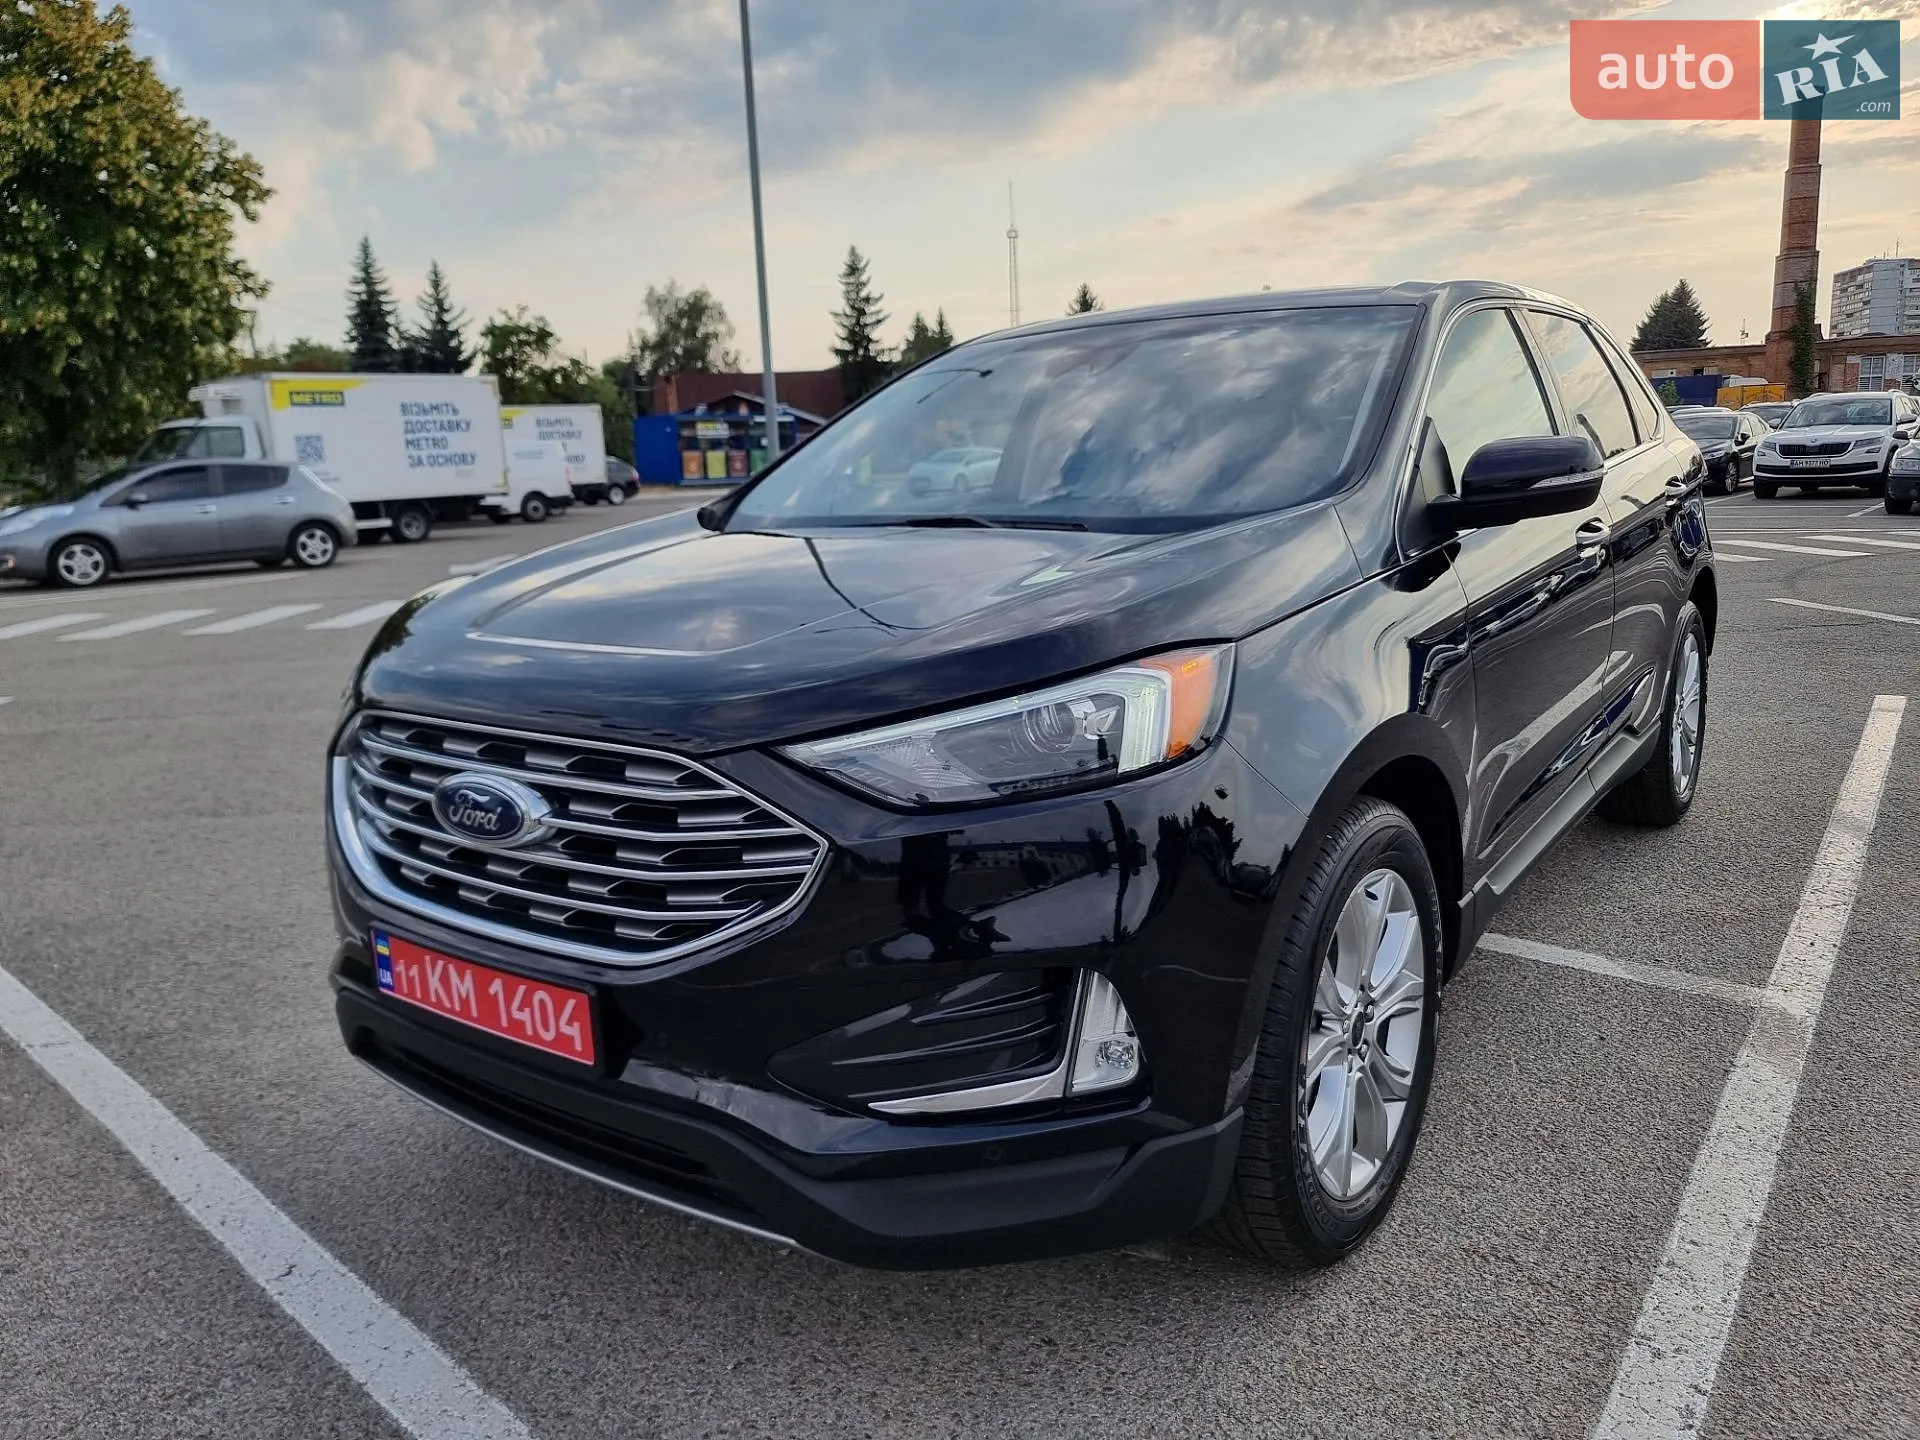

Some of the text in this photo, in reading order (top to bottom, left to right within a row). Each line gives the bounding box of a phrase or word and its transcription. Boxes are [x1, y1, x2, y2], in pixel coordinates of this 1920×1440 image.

[292, 392, 342, 405] METRO
[401, 402, 459, 416] ВІЗЬМІТЬ
[404, 419, 471, 434] ДОСТАВКУ
[405, 436, 448, 450] METRO
[408, 452, 477, 468] ЗА ОСНОВУ
[449, 789, 502, 830] Ford
[379, 968, 393, 986] UA
[488, 978, 582, 1052] 1404
